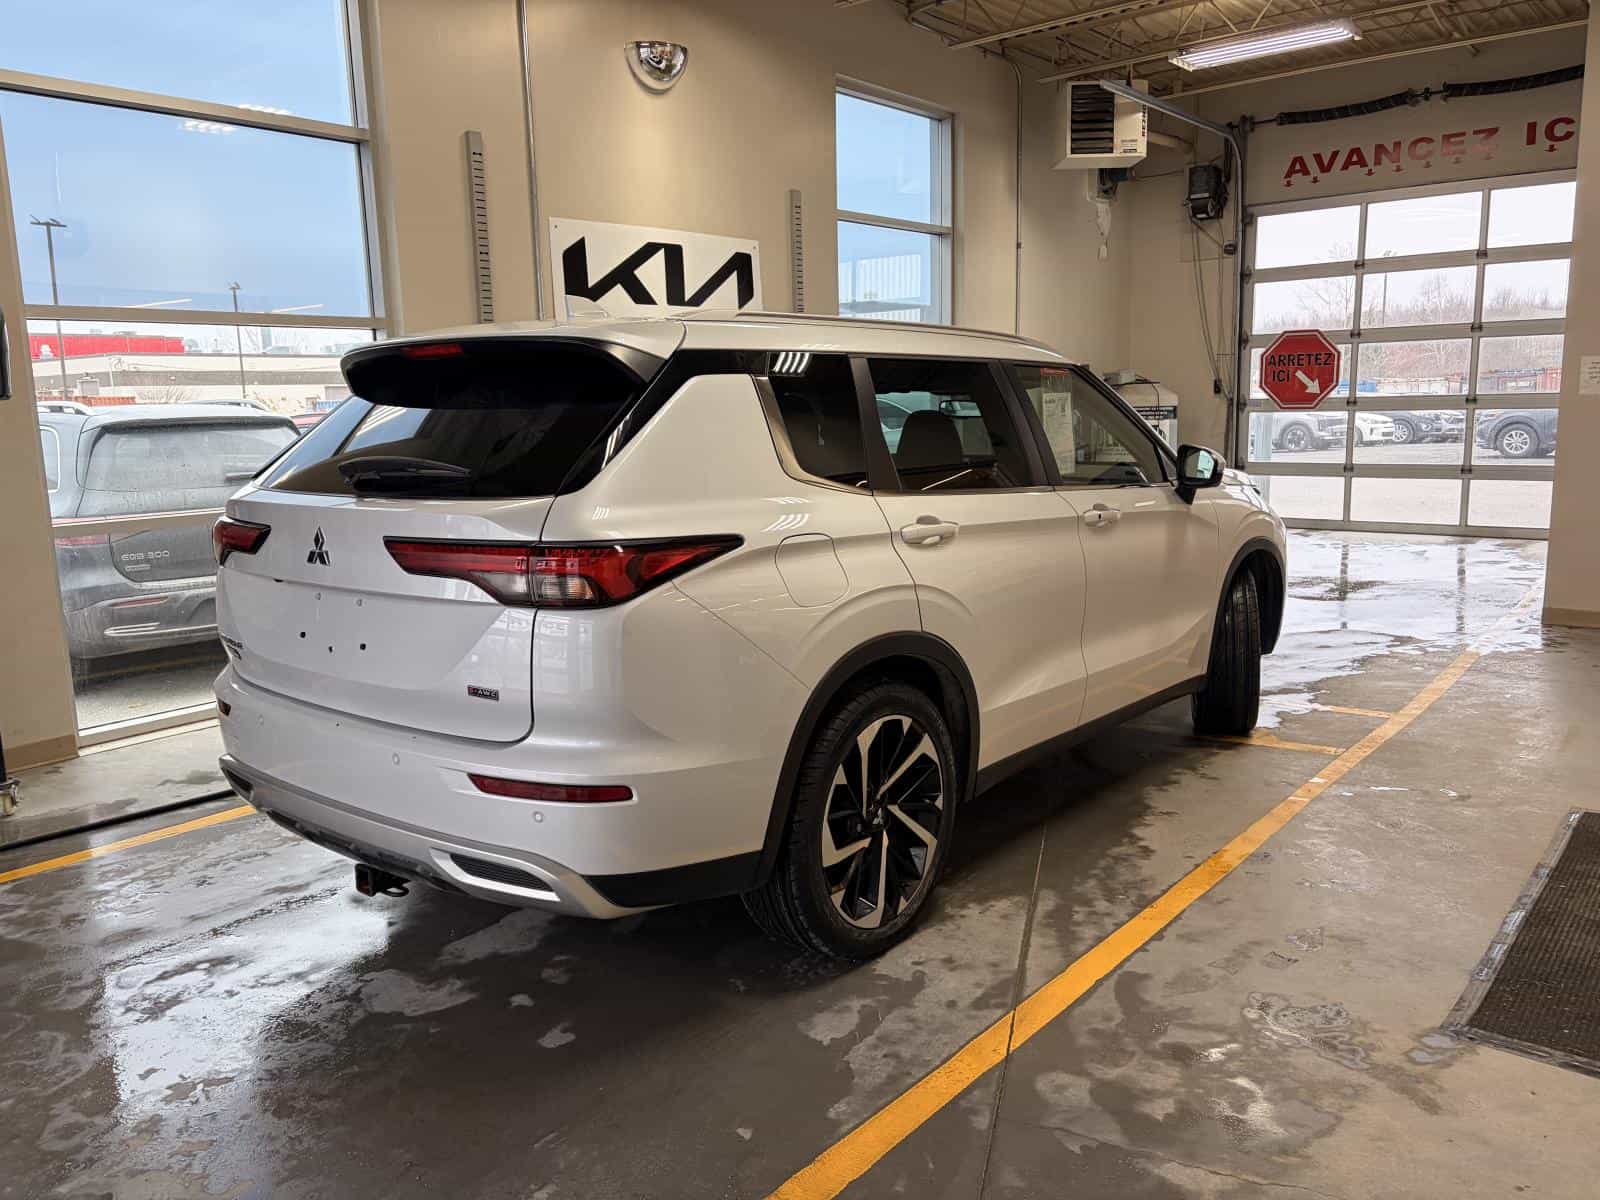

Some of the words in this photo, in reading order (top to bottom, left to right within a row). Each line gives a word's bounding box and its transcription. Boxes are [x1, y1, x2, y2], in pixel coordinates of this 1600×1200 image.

[1284, 126, 1500, 180] AVANCEZ
[562, 236, 754, 310] KIA
[1268, 352, 1333, 368] ARRETEZ
[1272, 369, 1291, 383] ICI
